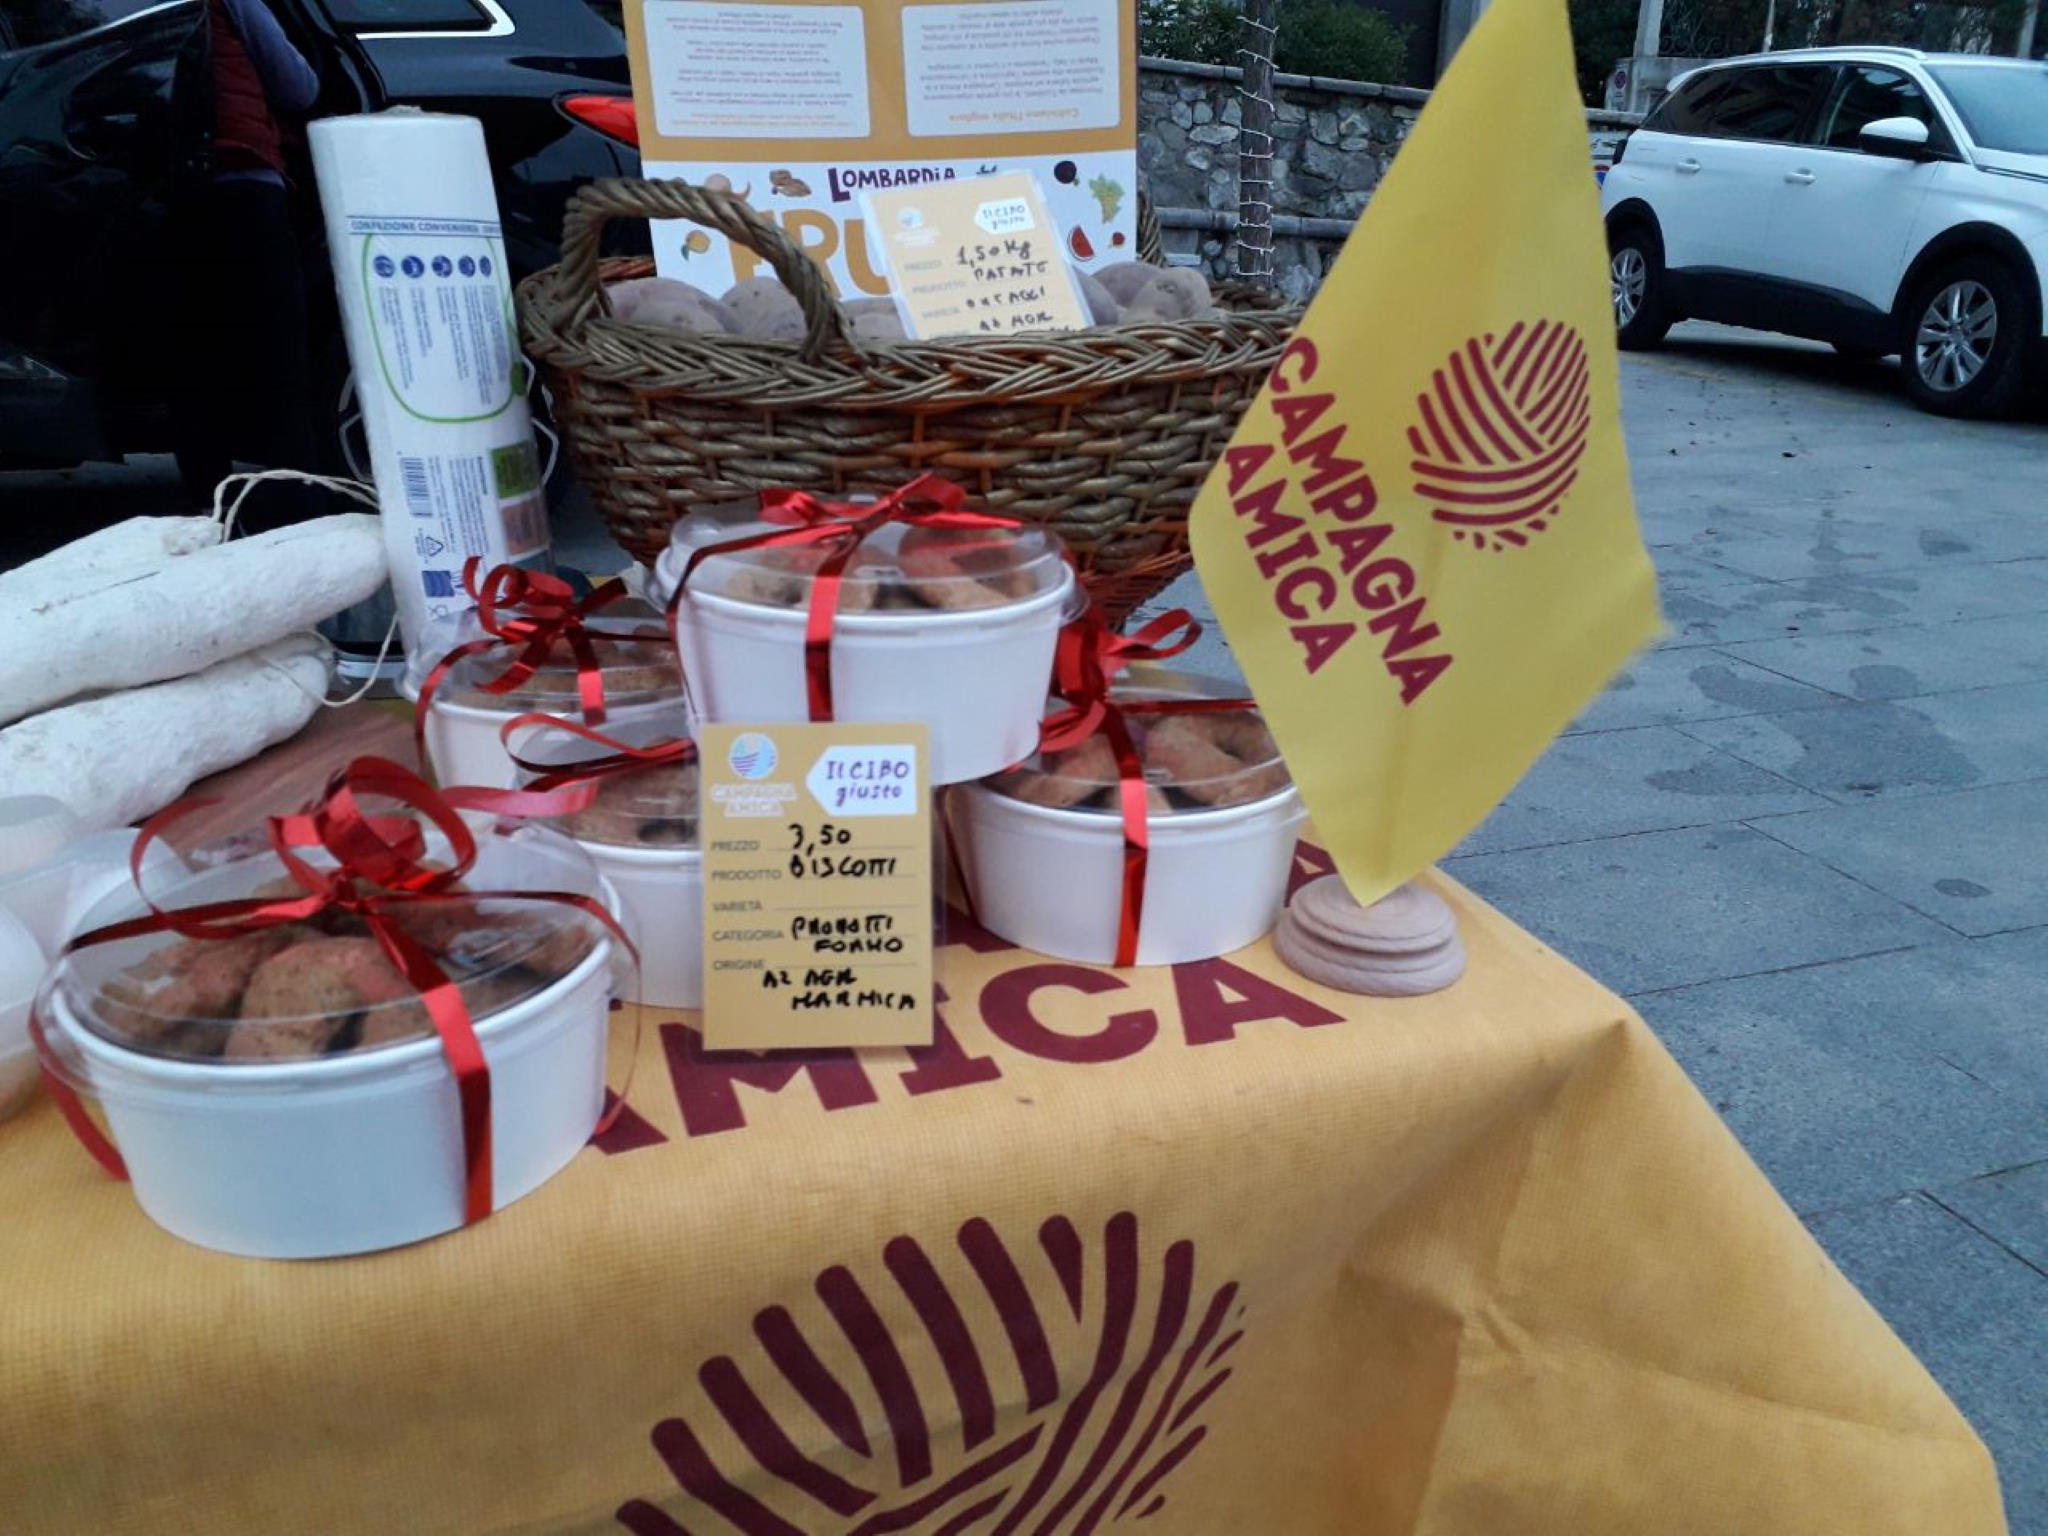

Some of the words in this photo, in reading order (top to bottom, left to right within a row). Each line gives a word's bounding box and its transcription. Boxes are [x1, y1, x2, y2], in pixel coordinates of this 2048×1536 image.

[1269, 336, 1454, 706] CAMPAGNA
[1225, 444, 1358, 675] AMICA
[849, 759, 910, 780] CIBO
[836, 783, 902, 807] giusto
[711, 841, 760, 851] PREZZO
[789, 823, 851, 856] 3,50
[711, 868, 782, 880] PRODOTTO
[789, 855, 897, 878] BISCOTTI
[712, 929, 784, 941] CATEGORIA
[713, 959, 765, 970] ORIGINE
